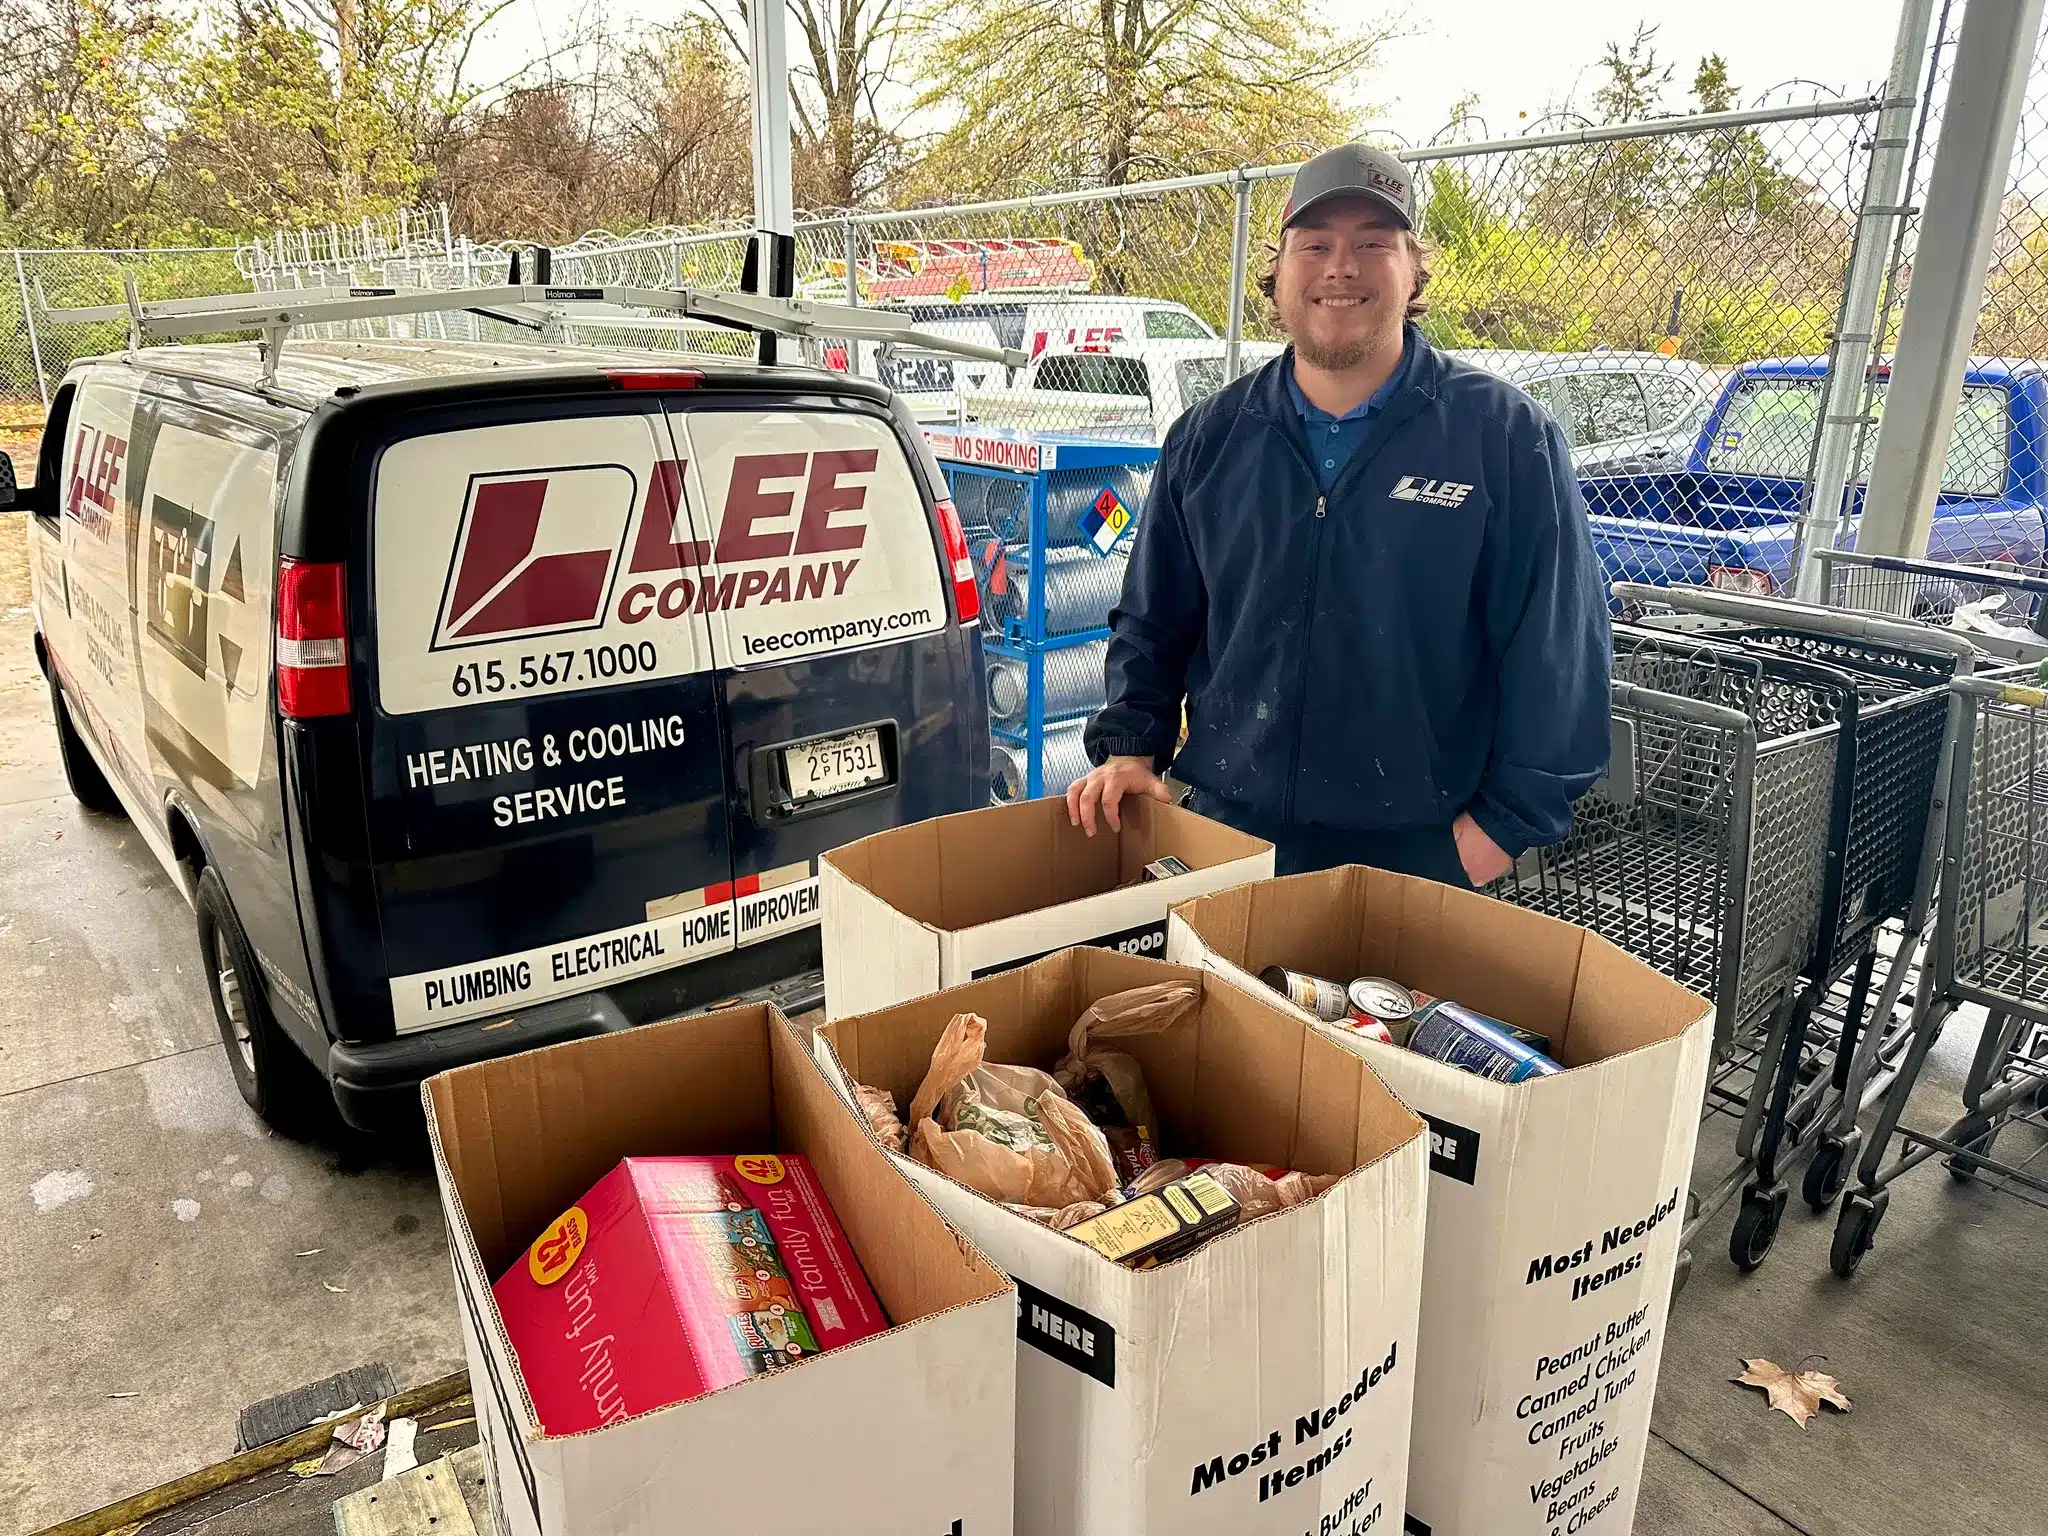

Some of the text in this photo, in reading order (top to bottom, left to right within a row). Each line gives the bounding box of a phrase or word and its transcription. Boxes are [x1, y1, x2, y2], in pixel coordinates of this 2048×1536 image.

[546, 290, 577, 299] Holman
[84, 430, 128, 514] LEE
[954, 435, 972, 459] NO
[975, 440, 1038, 469] SMOKING
[629, 449, 878, 574] LEE
[1100, 494, 1110, 515] 4
[1416, 496, 1461, 509] COMPANY
[1420, 480, 1474, 502] LEE
[1113, 509, 1123, 529] 0
[617, 559, 860, 625] COMPANY
[743, 608, 931, 656] leecompany.com
[452, 641, 657, 697] 615.567.1000
[406, 715, 685, 788] HEATING & COOLING
[810, 738, 856, 756] Tennessee
[493, 775, 626, 827] SERVICE
[425, 885, 820, 1011] PLUMBING ELECTRICAL HOME IMPROVEM
[742, 1159, 770, 1179] 42
[768, 1160, 781, 1178] BAGS
[1429, 1131, 1458, 1161] RE
[767, 1188, 796, 1222] fun
[783, 1189, 798, 1204] MIX
[537, 1224, 571, 1274] 42
[566, 1217, 582, 1249] BAGS
[1526, 1186, 1679, 1285] Most Needed
[583, 1258, 598, 1287] MIX
[782, 1227, 827, 1293] family
[1571, 1251, 1643, 1302] Items:
[564, 1268, 597, 1340] fun
[737, 1311, 768, 1350] RUFFLES
[1031, 1303, 1095, 1357] HERE
[1535, 1303, 1649, 1381] Peanut Butter
[1516, 1328, 1651, 1420] Canned Chicken
[1190, 1340, 1398, 1497] Most Needed
[1528, 1368, 1637, 1446] Canned Tuna
[1259, 1427, 1353, 1503] Items:
[1559, 1420, 1605, 1461] Fruits
[1530, 1436, 1619, 1505] Vegetables
[1320, 1477, 1373, 1536] Butter
[1546, 1480, 1596, 1524] Beans
[1567, 1486, 1619, 1535] Cheese
